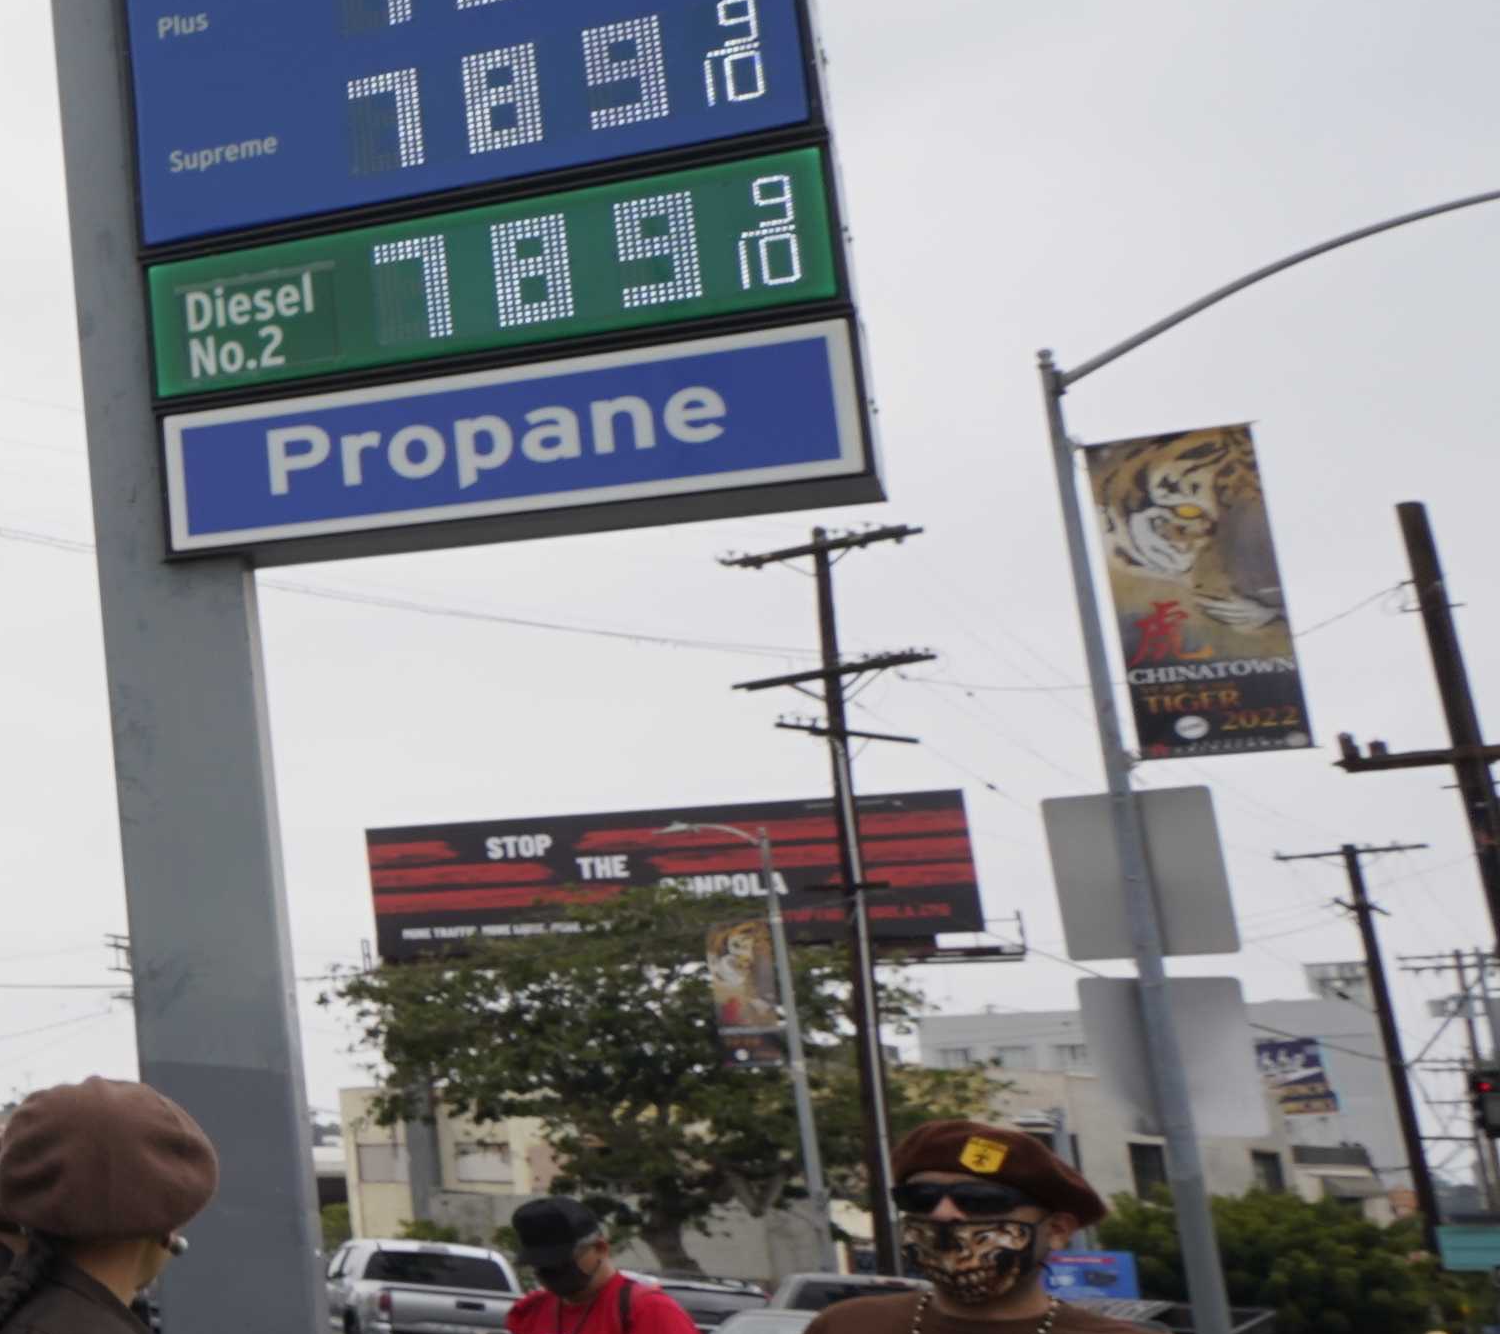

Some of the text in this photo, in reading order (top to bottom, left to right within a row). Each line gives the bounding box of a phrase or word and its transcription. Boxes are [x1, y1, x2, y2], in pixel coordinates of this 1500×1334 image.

[157, 10, 210, 40] Plus
[169, 132, 279, 175] Supreme
[185, 272, 315, 334] Diesel
[189, 327, 287, 378] No.2
[265, 385, 728, 496] Propane
[1128, 600, 1216, 668] 虎
[1127, 656, 1298, 685] CHINATOWN
[1143, 689, 1241, 714] TIGER
[1221, 704, 1300, 731] 2022
[485, 833, 554, 860] STOP
[574, 854, 631, 880] THE
